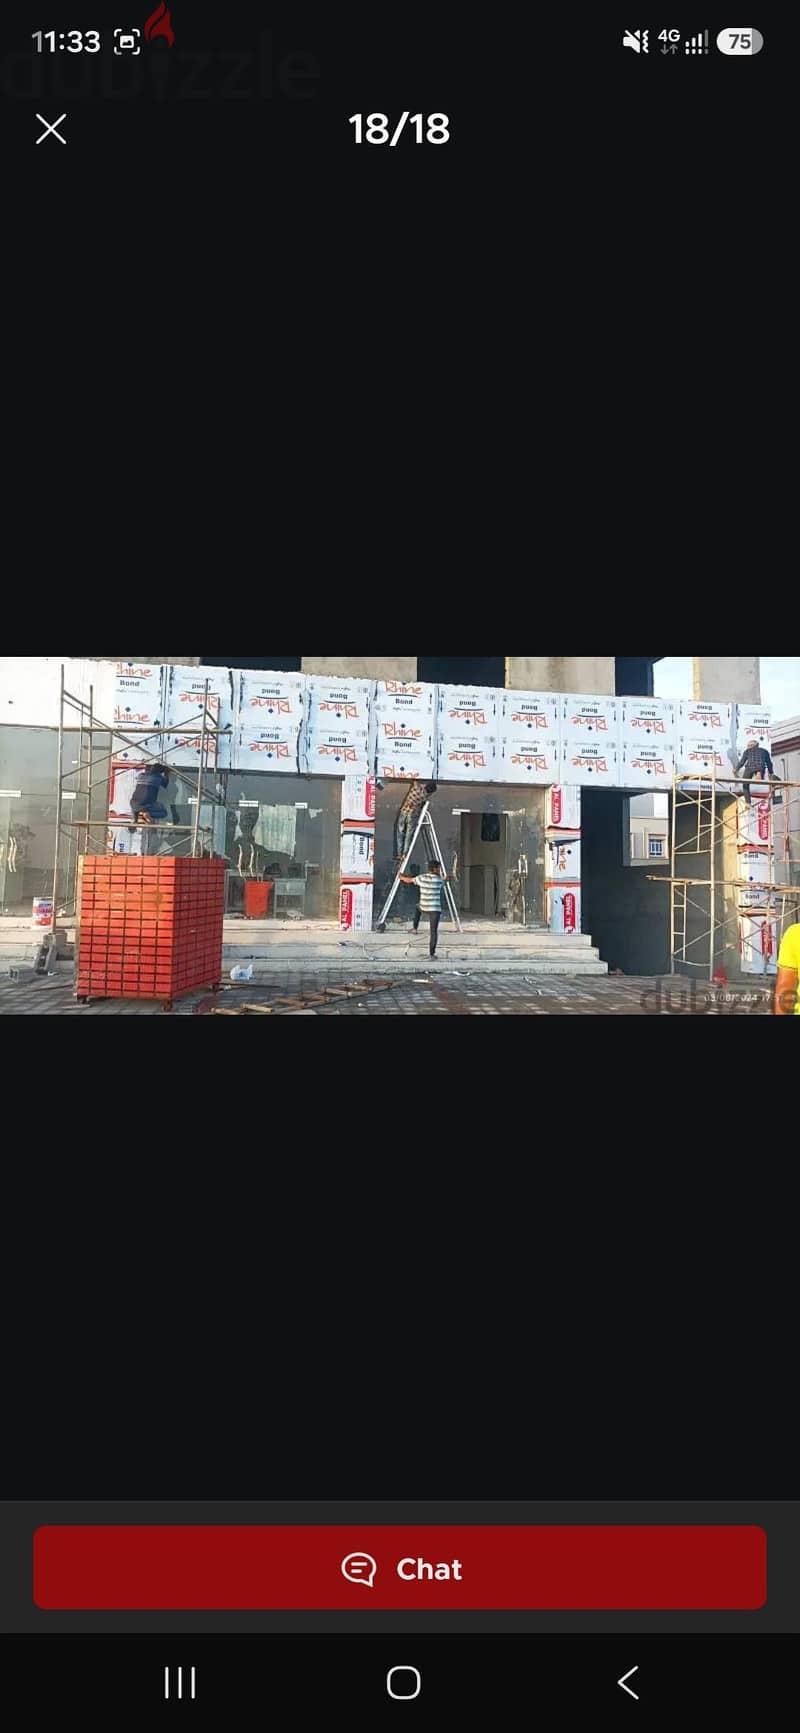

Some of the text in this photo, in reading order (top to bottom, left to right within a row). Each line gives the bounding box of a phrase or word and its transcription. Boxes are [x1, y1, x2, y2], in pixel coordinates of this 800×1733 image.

[31, 30, 101, 53] 11:33
[657, 28, 681, 42] 4G
[728, 33, 751, 49] 75
[348, 111, 450, 147] 18/18
[384, 681, 424, 695] Rhine
[249, 699, 293, 715] Rhine
[317, 702, 360, 719] Rhine
[448, 710, 488, 726] Rhine
[511, 714, 549, 729] Rhine
[571, 716, 609, 732] Rhine
[688, 713, 724, 728] Rhine
[381, 720, 423, 738] Rhine
[630, 719, 666, 735] Rhine
[260, 732, 280, 740] Bond
[248, 742, 292, 759] Rhine
[316, 746, 359, 763] Rhine
[447, 752, 487, 768] Rhine
[510, 755, 549, 771] Rhine
[570, 758, 609, 774] Rhine
[630, 760, 667, 776] Rhine
[397, 1557, 463, 1581] Chat
